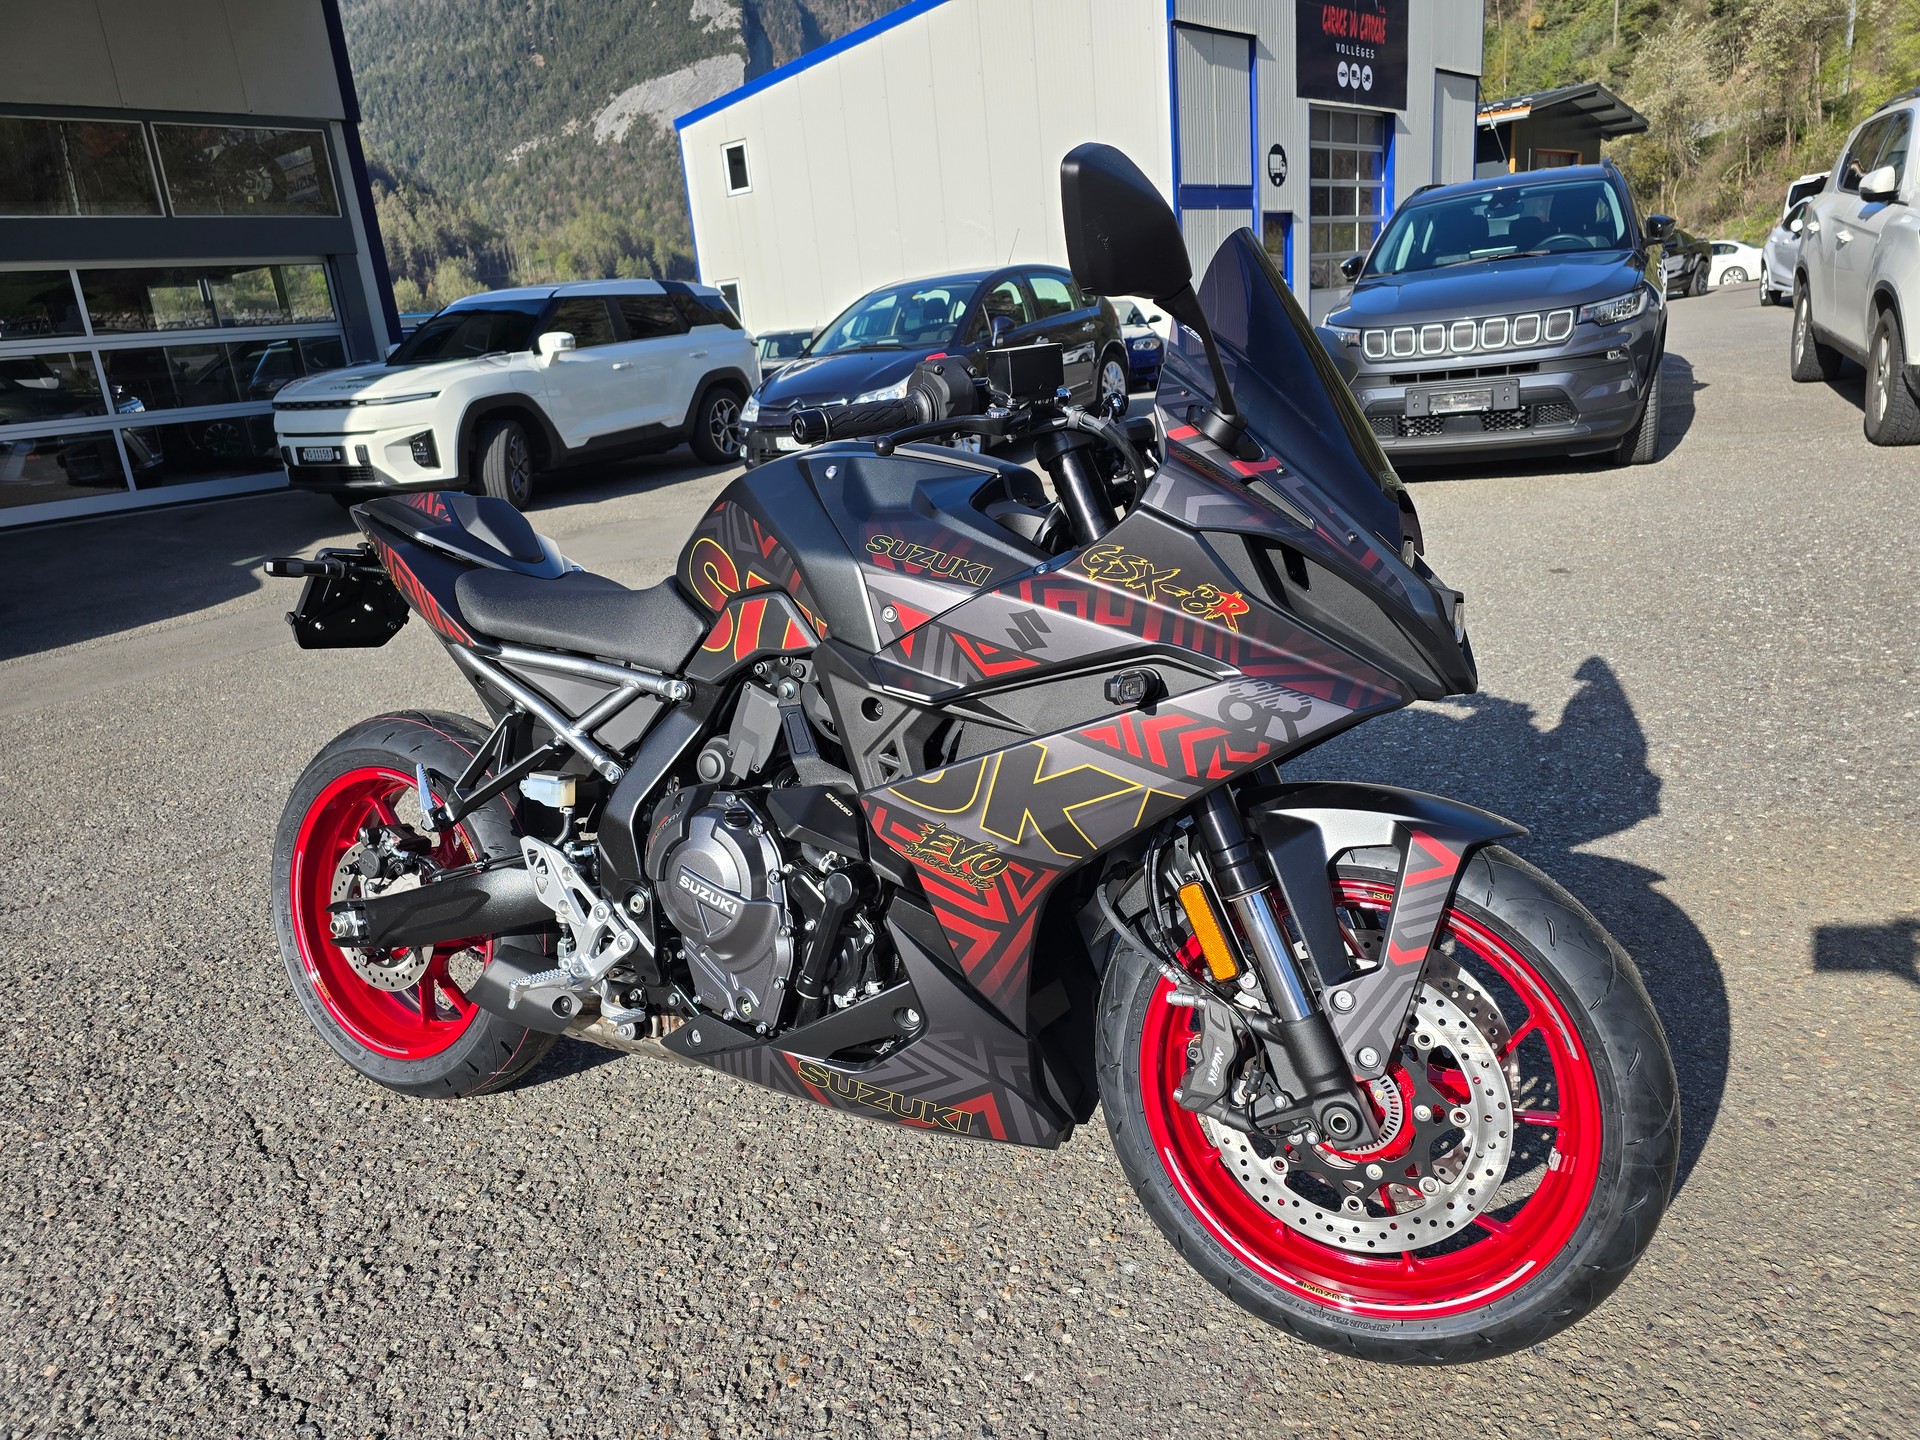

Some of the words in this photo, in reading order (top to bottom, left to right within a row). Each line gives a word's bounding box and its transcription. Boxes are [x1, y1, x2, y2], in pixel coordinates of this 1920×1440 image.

[1335, 43, 1375, 59] VOLLÈGES
[865, 534, 994, 587] SUZUKI
[1081, 543, 1250, 634] GSX-8R
[825, 792, 854, 817] SUZUKI
[910, 822, 1010, 880] EVO
[678, 875, 738, 915] SUZUKI
[797, 1060, 973, 1134] SUZUKI
[1303, 1281, 1350, 1302] SUZUKI
